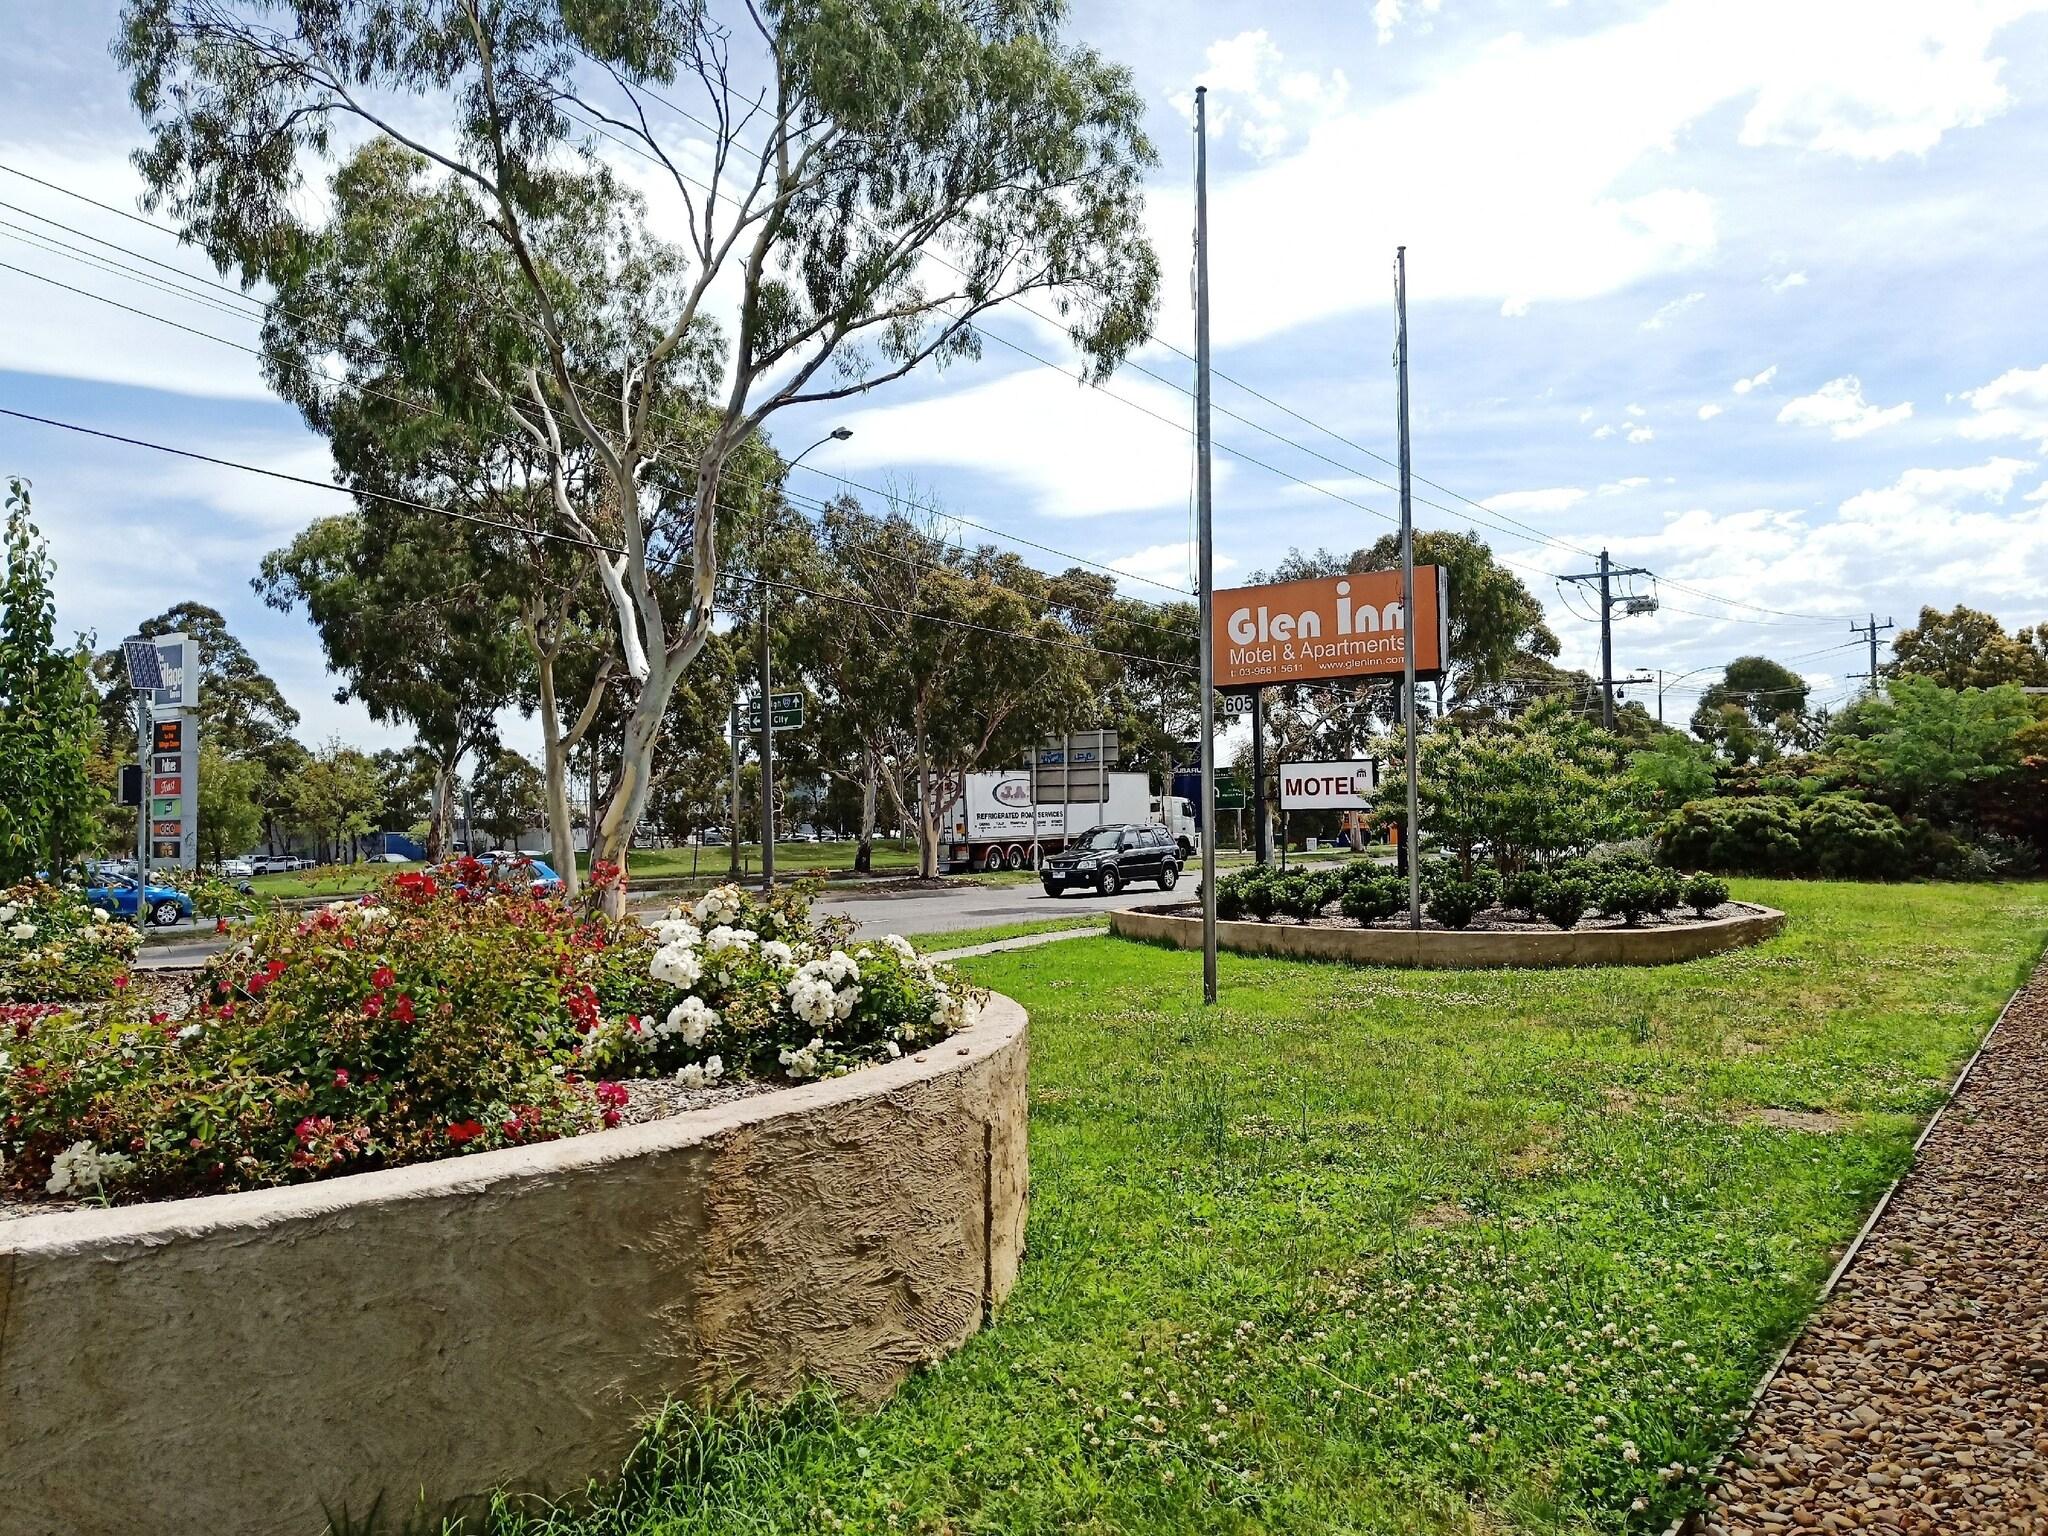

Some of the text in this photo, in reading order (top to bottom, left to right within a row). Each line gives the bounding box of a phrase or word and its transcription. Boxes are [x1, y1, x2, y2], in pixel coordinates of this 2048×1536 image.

[1227, 606, 1321, 646] Glen
[1229, 634, 1405, 666] Motel & Apartments
[160, 662, 182, 691] illage
[1225, 696, 1254, 713] 605
[1285, 776, 1362, 796] MOTEL
[976, 812, 1020, 820] REFRIGERATED
[1037, 810, 1064, 818] SERVICES
